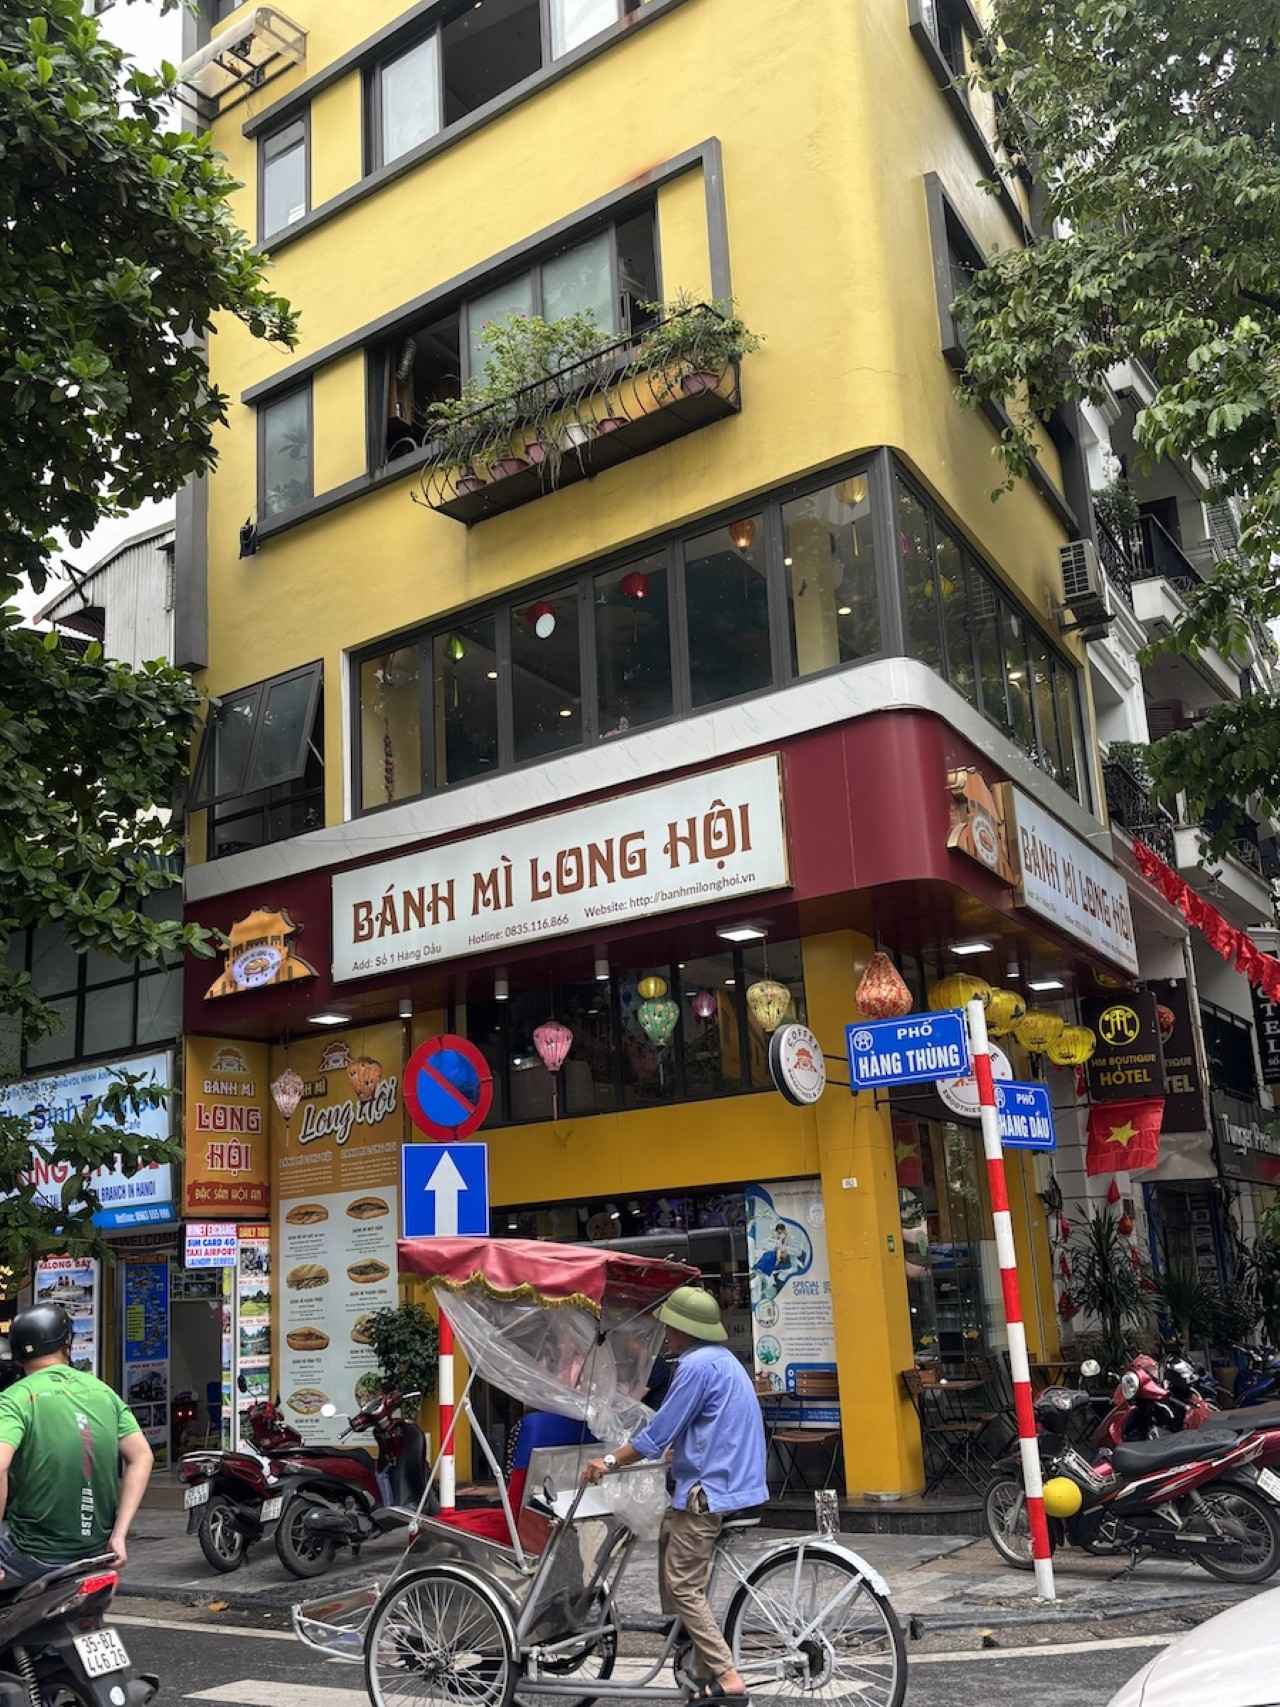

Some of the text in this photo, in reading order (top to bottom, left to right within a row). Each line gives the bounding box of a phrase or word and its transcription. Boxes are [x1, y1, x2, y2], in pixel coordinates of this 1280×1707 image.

[352, 799, 754, 944] BÁNH MÌ LONG HỘI
[352, 958, 374, 972] Add:
[468, 929, 504, 946] Hotline:
[504, 913, 570, 938] 0835.116.866
[584, 899, 629, 918] Website:
[629, 872, 757, 909] http://banhmilonghoi.vn
[897, 1019, 934, 1040] PHỐ
[858, 1042, 961, 1079] HÀNG THÙNG
[1100, 1069, 1152, 1086] HOTEL
[1166, 1074, 1195, 1094] TEL
[1015, 1088, 1036, 1106] PHỐ
[196, 1103, 262, 1133] LONG
[299, 1100, 354, 1144] Long
[999, 1108, 1029, 1138] HÀNG
[205, 1137, 252, 1177] HỘI
[792, 1280, 819, 1289] SPECIAL
